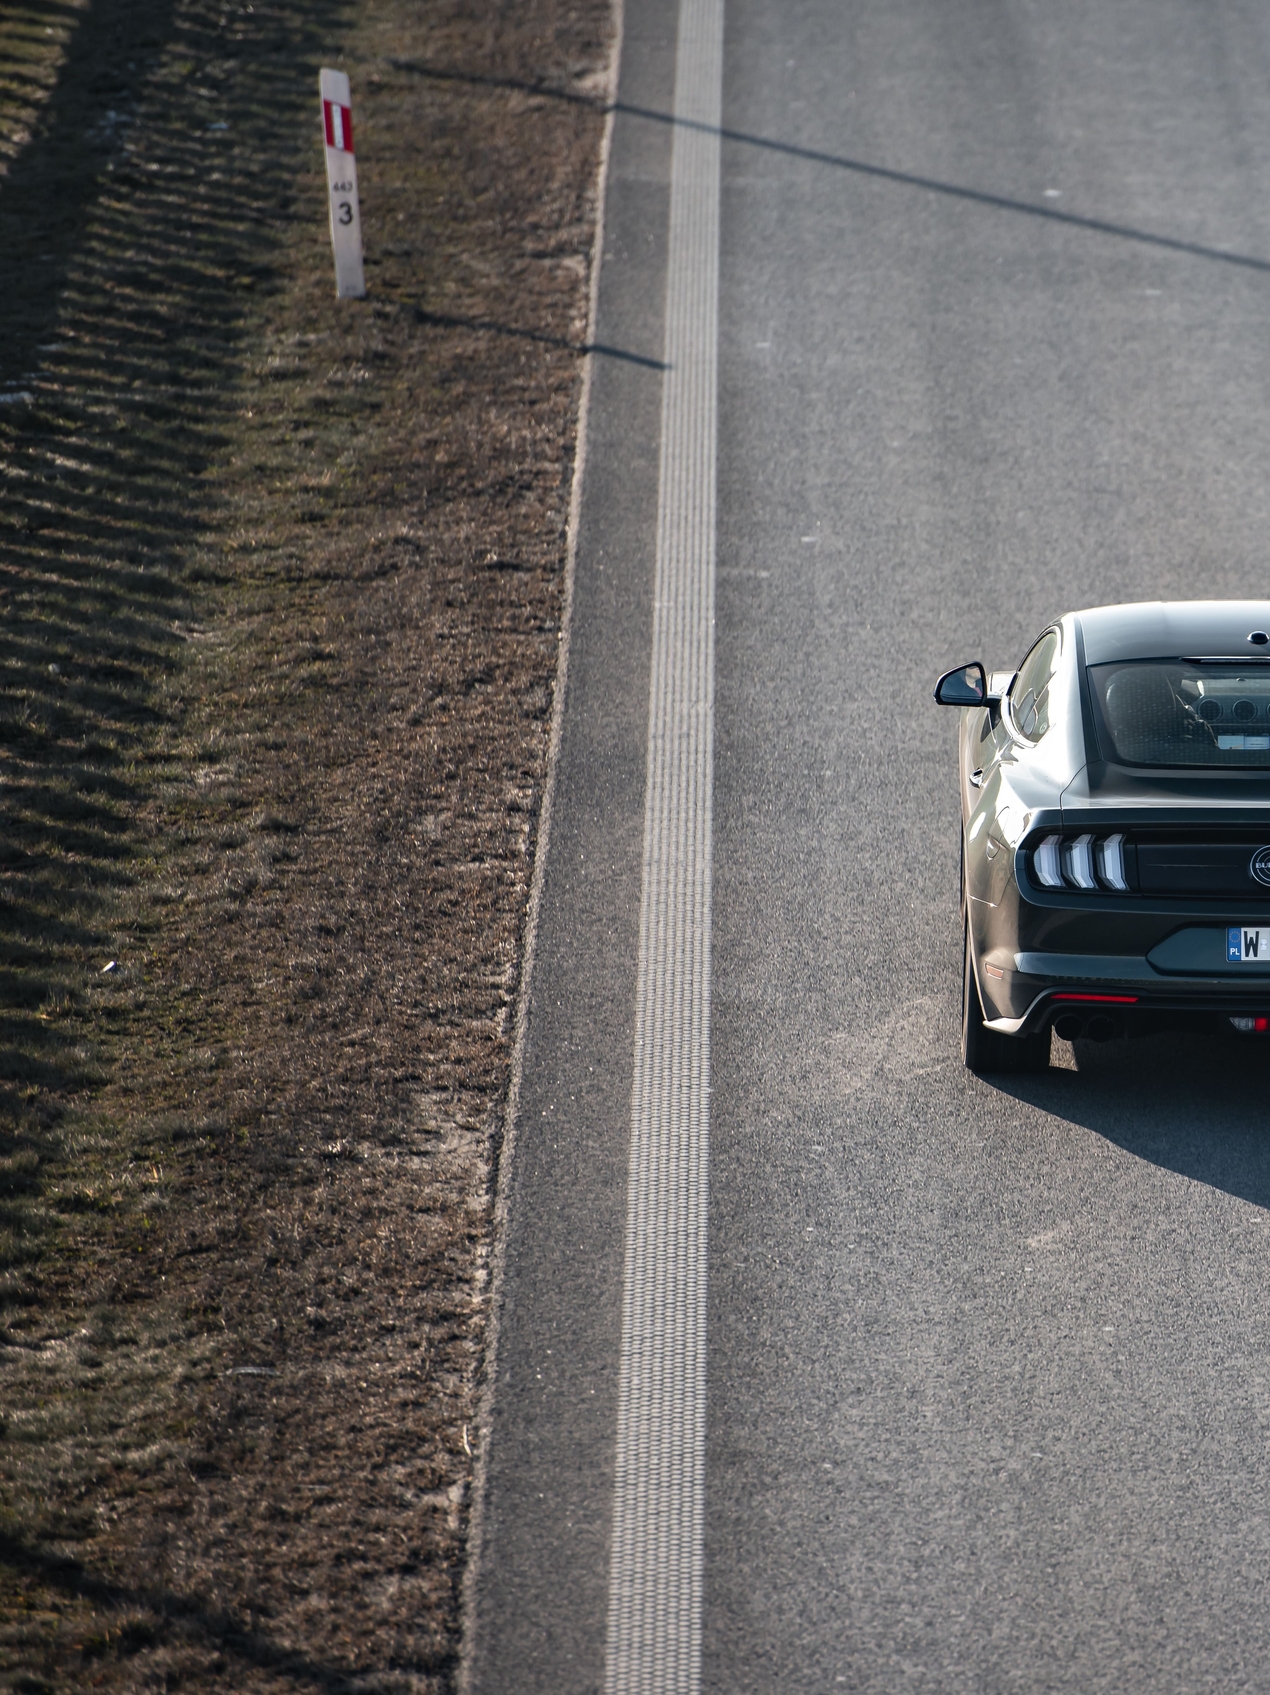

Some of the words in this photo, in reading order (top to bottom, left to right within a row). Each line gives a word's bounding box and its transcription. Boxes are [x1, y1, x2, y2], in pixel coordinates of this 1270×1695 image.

[339, 202, 353, 225] 3
[1229, 947, 1240, 955] PL
[1243, 931, 1259, 957] W
